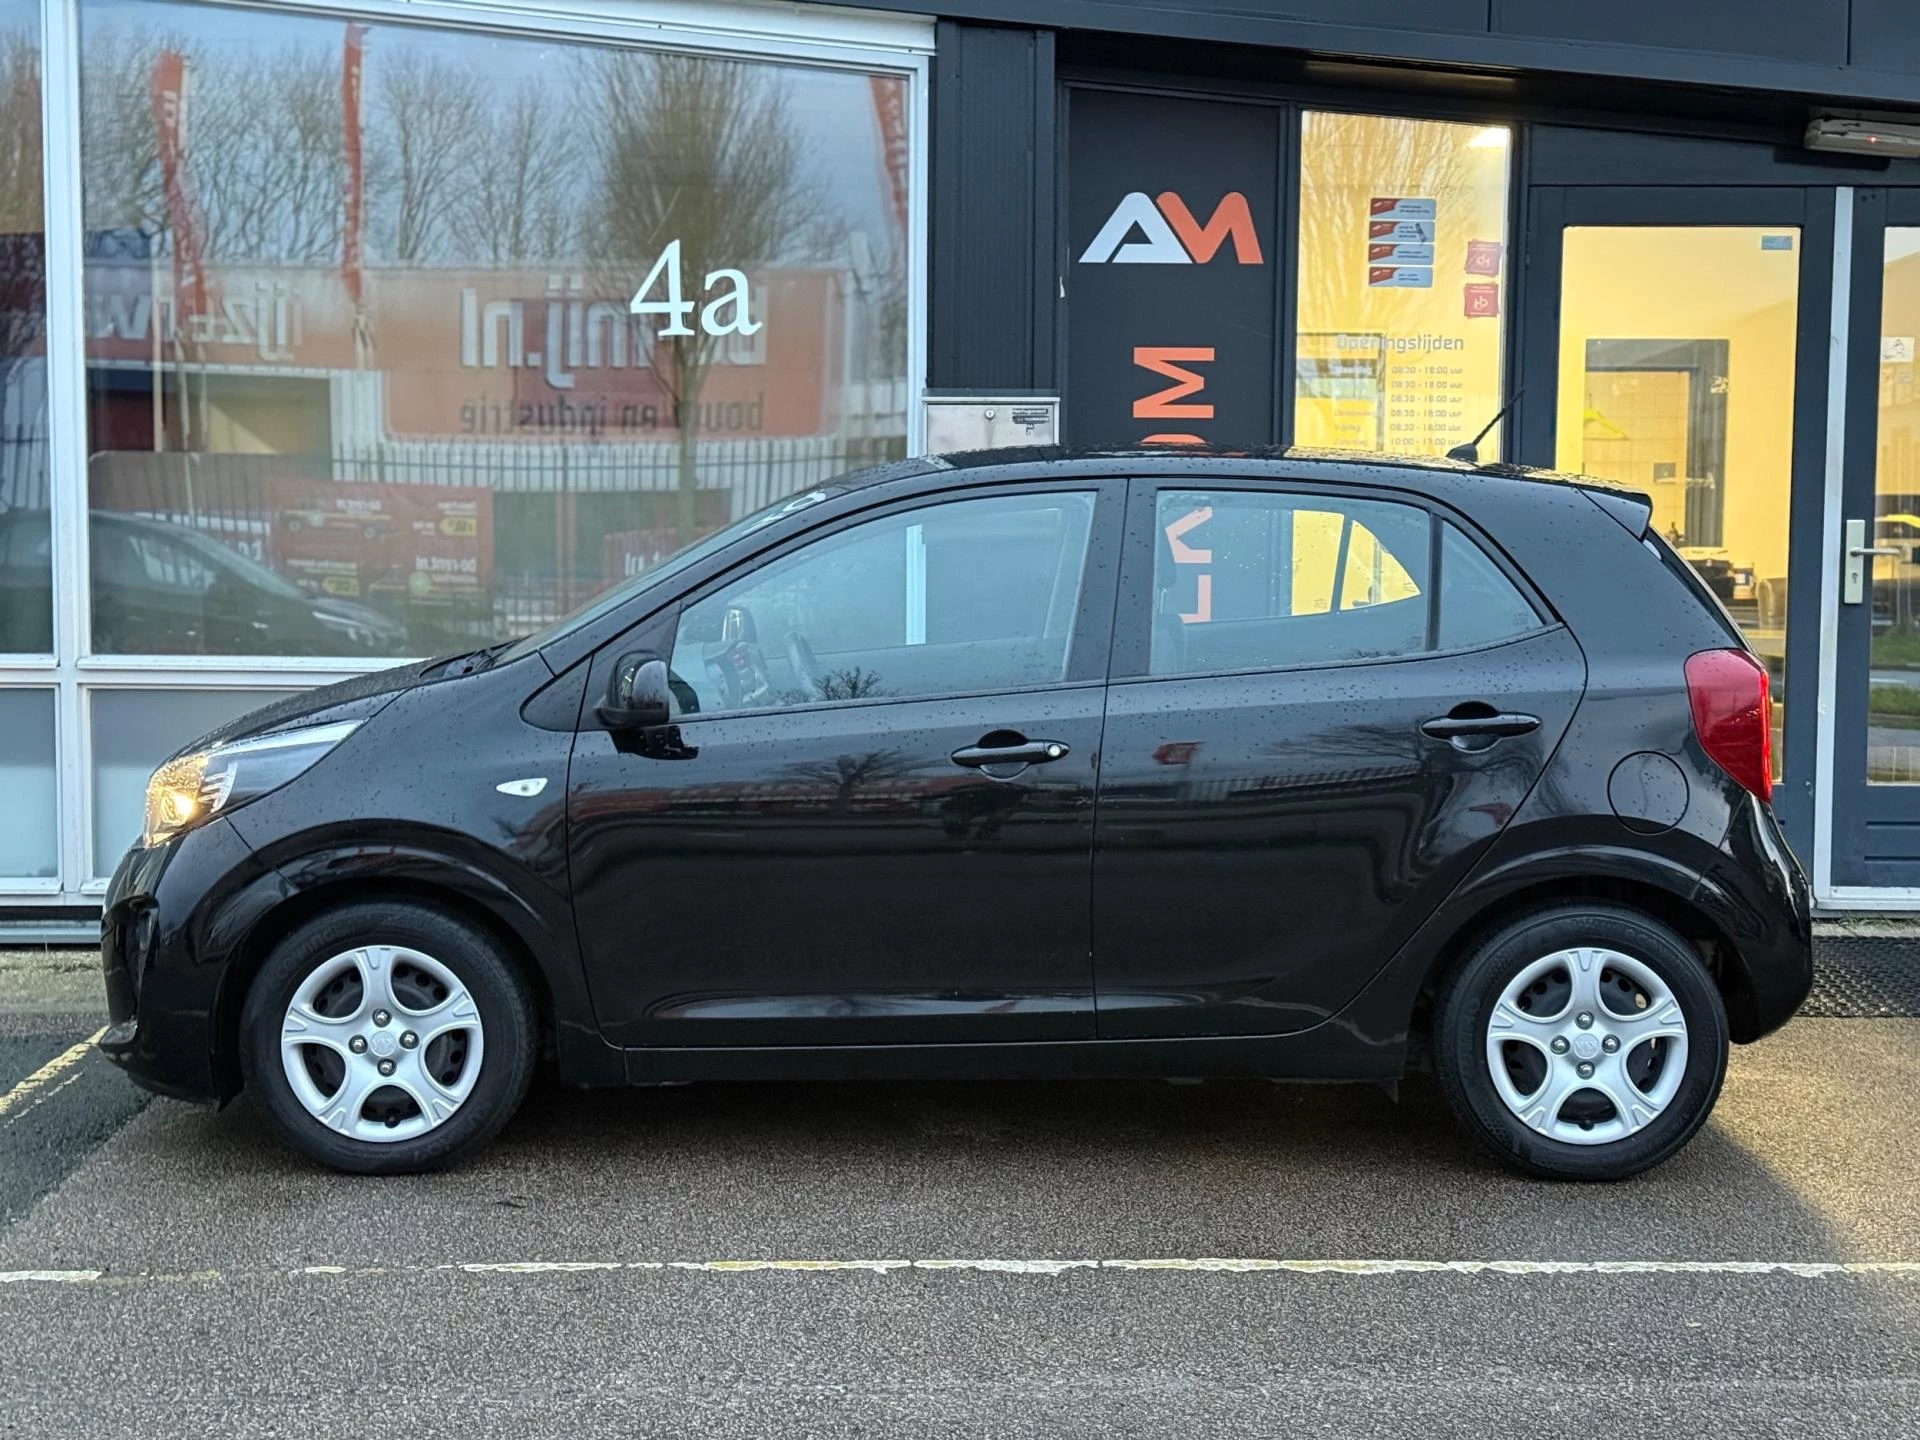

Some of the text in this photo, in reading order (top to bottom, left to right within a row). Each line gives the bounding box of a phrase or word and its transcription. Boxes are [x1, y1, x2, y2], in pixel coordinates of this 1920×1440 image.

[1078, 191, 1264, 265] AM
[629, 239, 762, 337] 4a
[1336, 333, 1464, 354] Openingstijden
